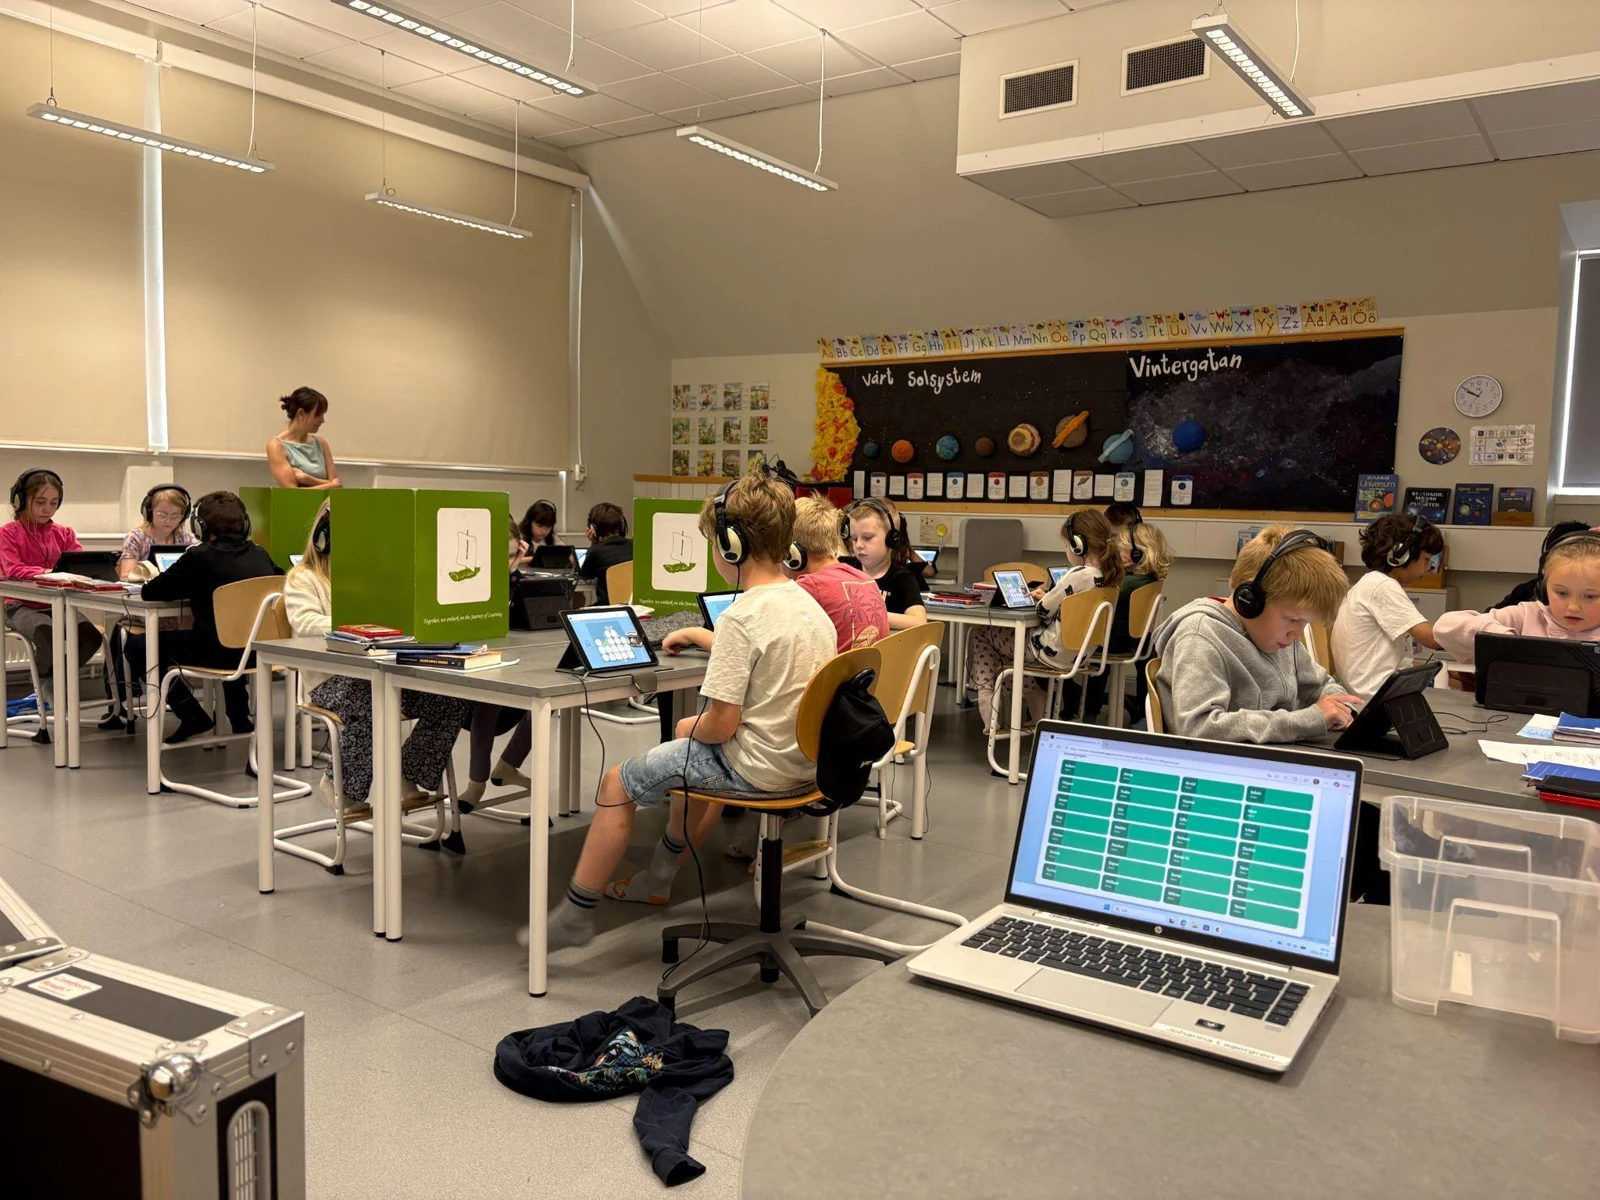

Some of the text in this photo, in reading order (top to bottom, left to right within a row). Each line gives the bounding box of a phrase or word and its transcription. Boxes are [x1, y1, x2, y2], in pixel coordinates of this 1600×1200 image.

[821, 349, 834, 358] Aa
[836, 347, 849, 358] Bb
[850, 346, 863, 357] Cc
[866, 345, 879, 356] Dd
[898, 343, 909, 354] Ff
[913, 342, 927, 355] Gg
[929, 340, 944, 351] Hh
[964, 339, 975, 352] Jj
[981, 337, 994, 348] Kk
[1000, 335, 1009, 346] Ll
[1013, 335, 1032, 345] Mm
[1033, 333, 1049, 344] Nn
[1051, 332, 1068, 343] Oo
[1073, 331, 1086, 344] Pp
[1090, 329, 1107, 344] Qq
[1111, 329, 1122, 339] Rr
[1130, 327, 1144, 338] Ss
[1150, 326, 1164, 337] Tt
[1170, 325, 1187, 336] Uu
[1191, 324, 1208, 335] Vv
[1210, 322, 1233, 333] Ww
[1235, 321, 1252, 332] Xx
[1257, 319, 1274, 335] Yy
[1282, 317, 1299, 330] Zz
[1305, 314, 1323, 327] Åå
[1329, 312, 1348, 326] Ää
[1353, 309, 1377, 324] Öö
[1129, 348, 1243, 382] Vintergatan
[908, 367, 982, 395] Solsystem
[1166, 1027, 1213, 1043] Johanna
